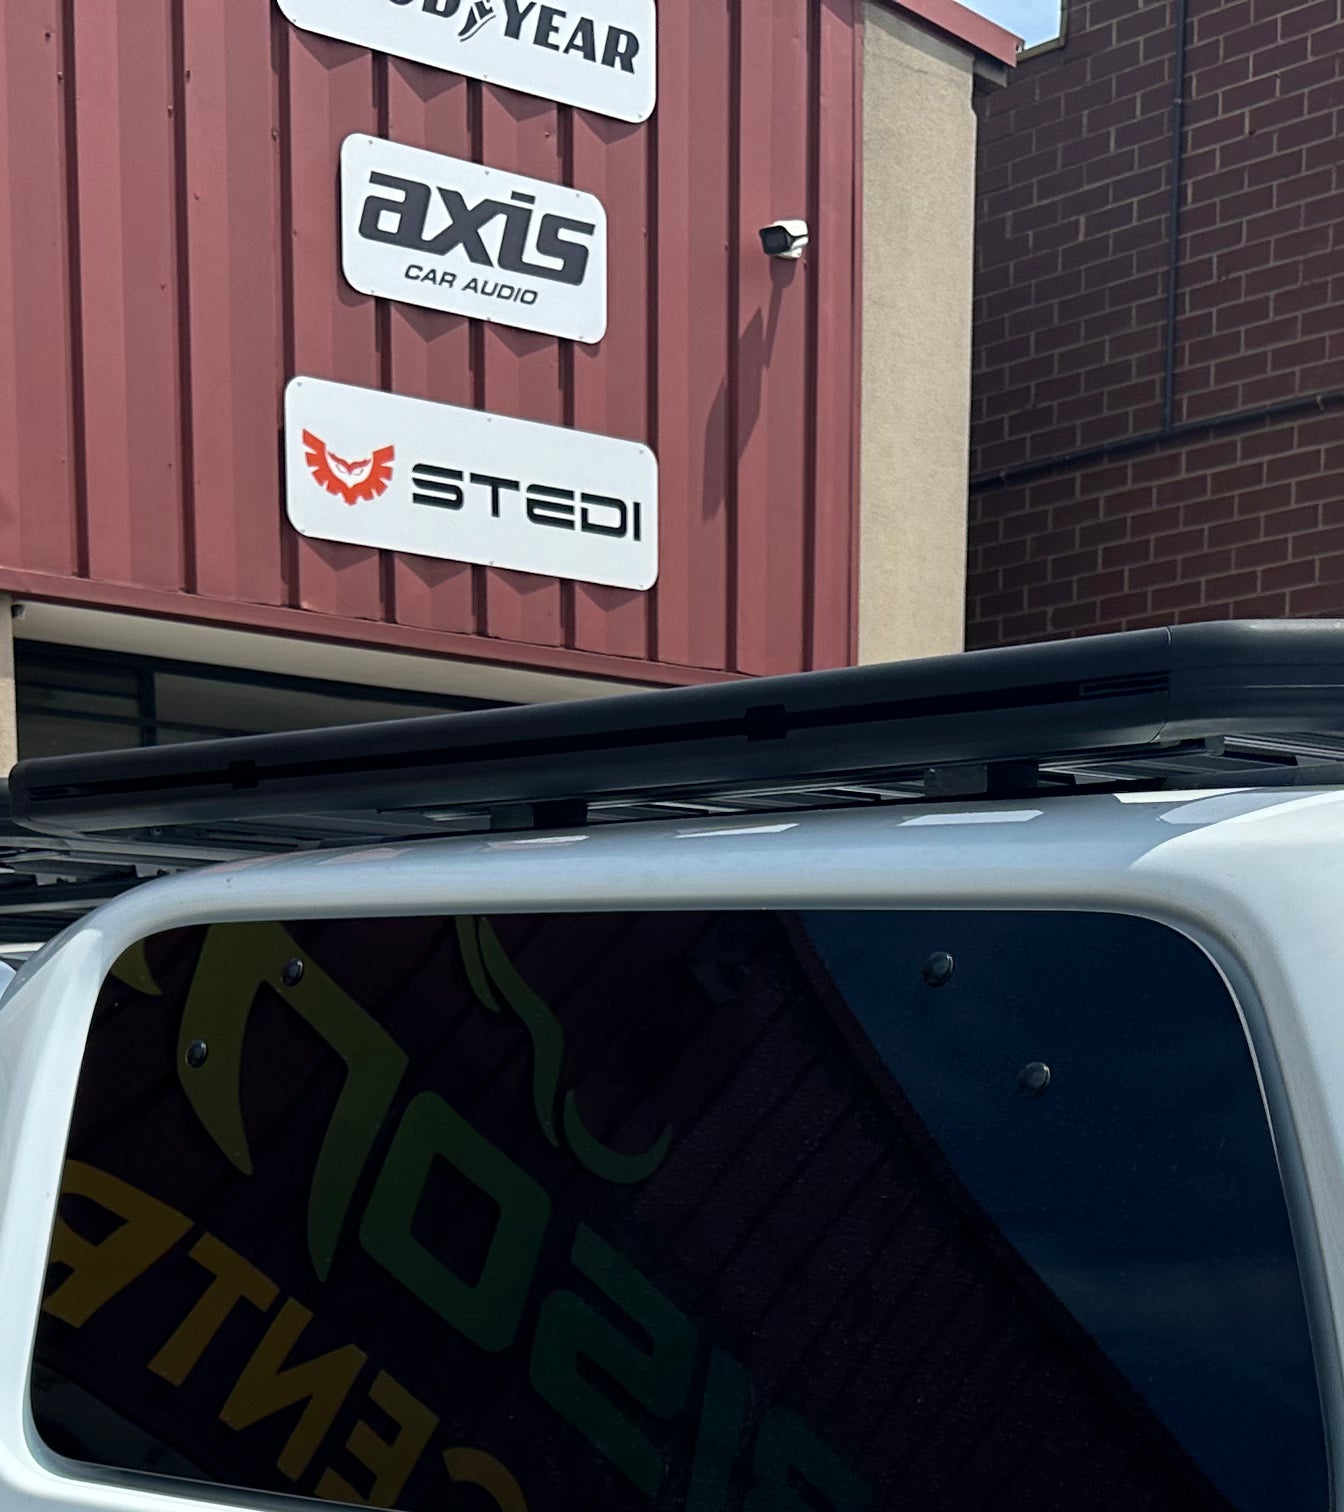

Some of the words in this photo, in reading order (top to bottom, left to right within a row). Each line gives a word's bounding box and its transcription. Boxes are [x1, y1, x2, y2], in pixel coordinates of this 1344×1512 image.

[358, 170, 596, 286] axis
[404, 263, 457, 290] CAR
[462, 276, 539, 305] AUDIO
[411, 462, 642, 542] STEDI
